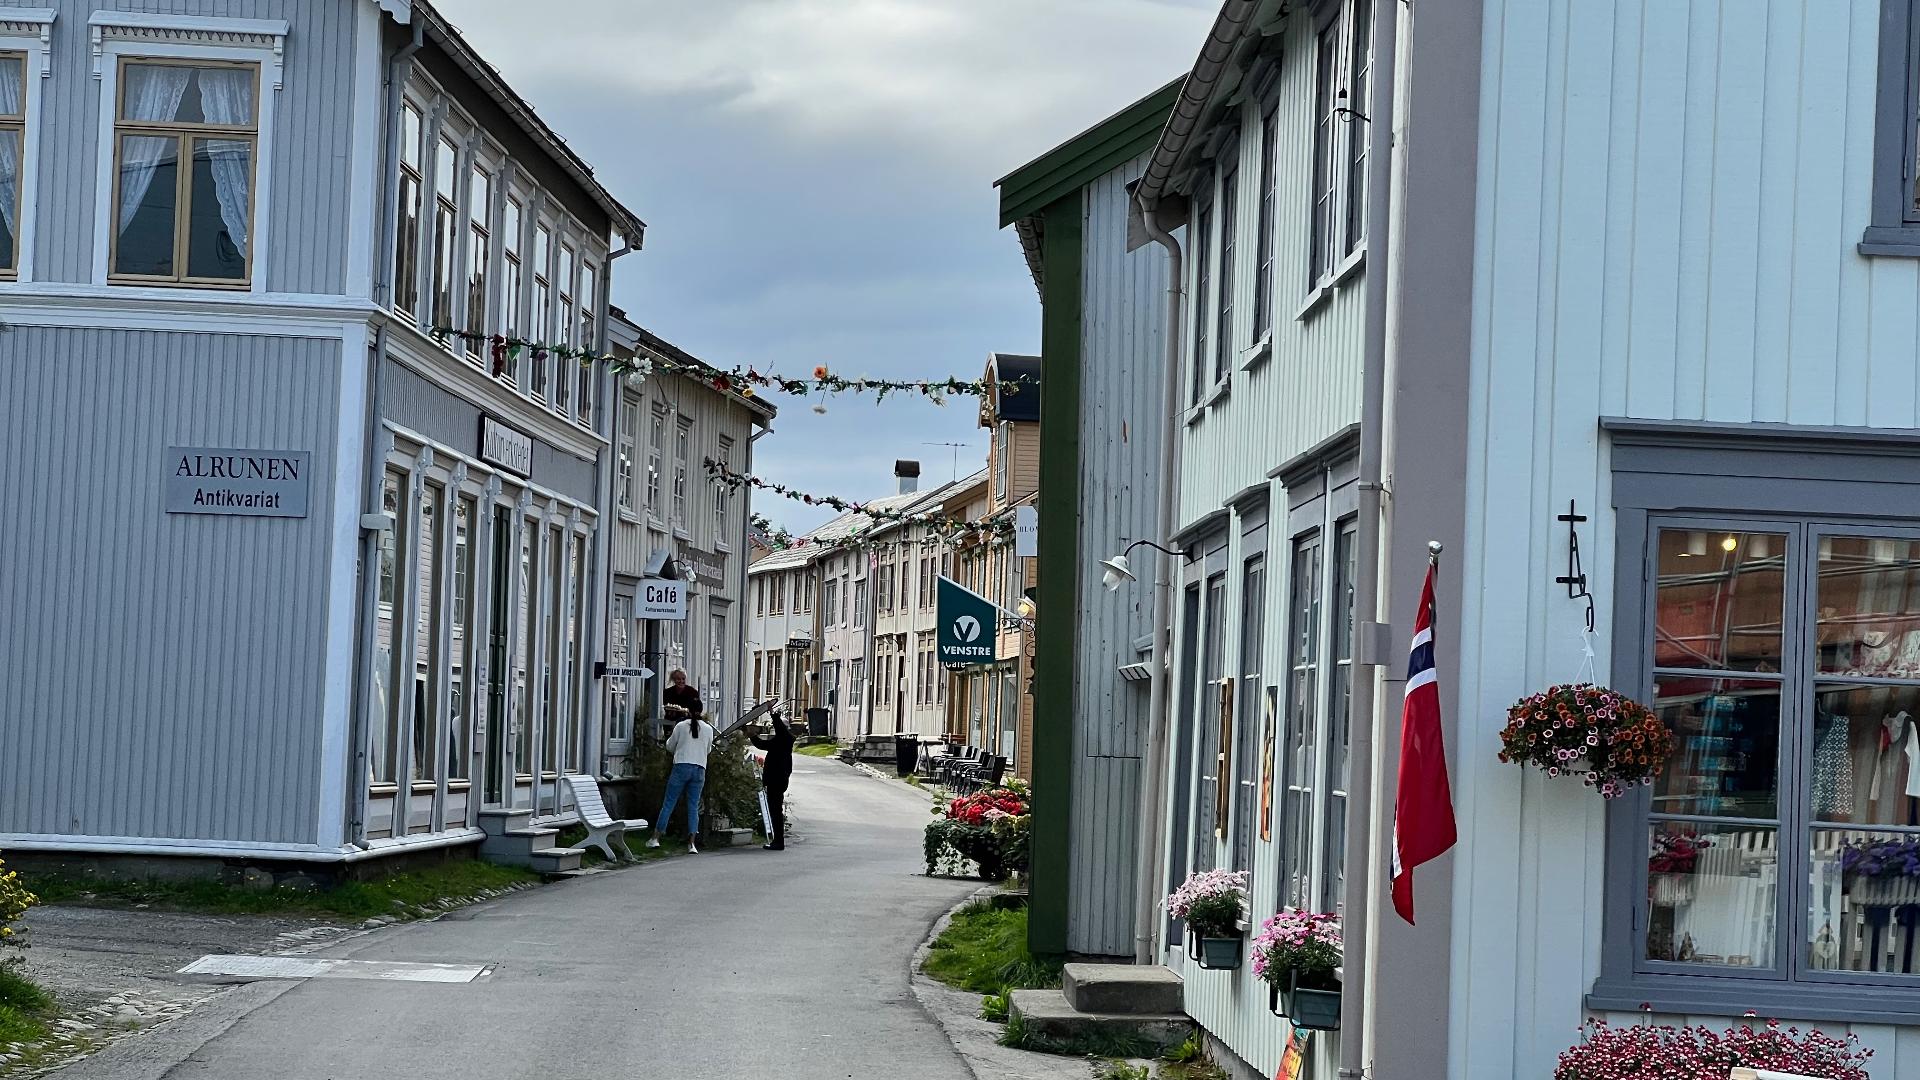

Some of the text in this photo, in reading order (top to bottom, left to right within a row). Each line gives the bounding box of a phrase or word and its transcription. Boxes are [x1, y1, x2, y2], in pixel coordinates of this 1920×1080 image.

[176, 455, 300, 480] ALRUNEN
[193, 488, 280, 508] Antikvariat
[646, 585, 677, 603] Café
[942, 645, 991, 656] VENSTRE
